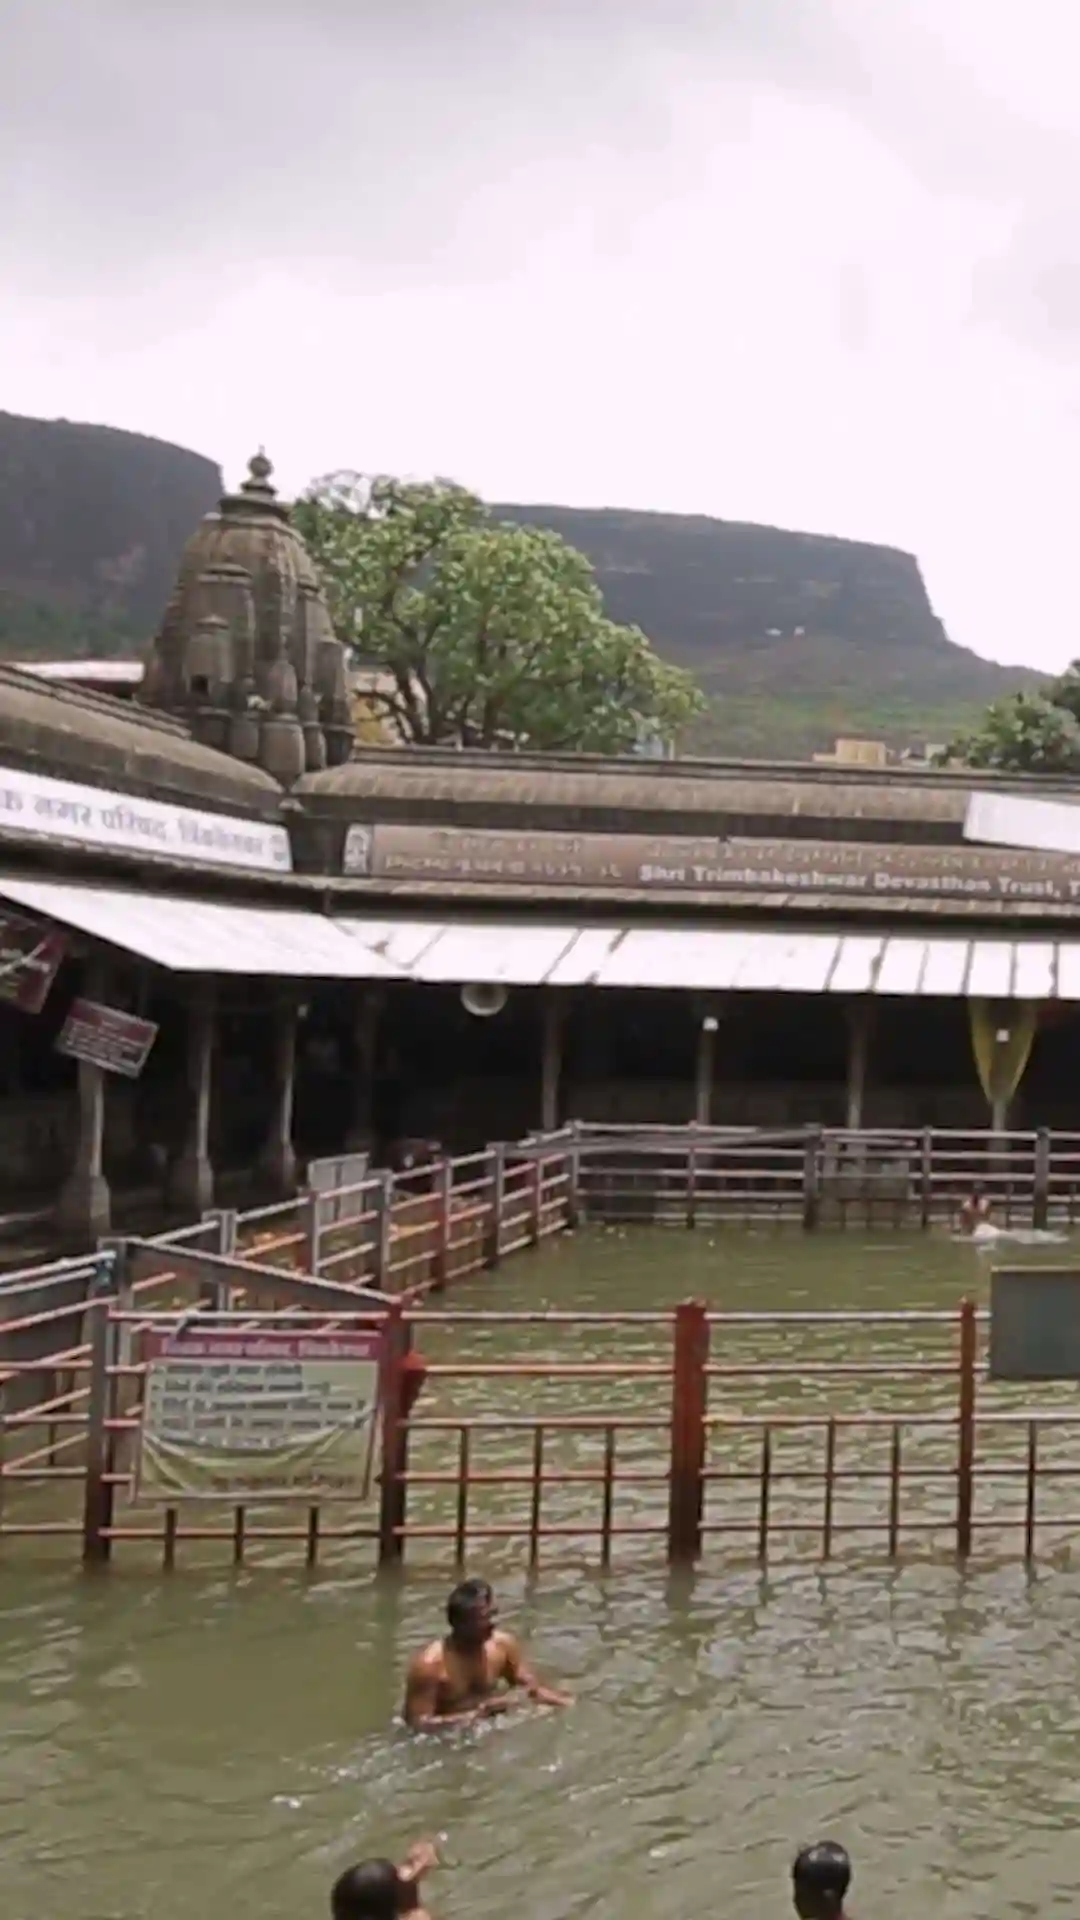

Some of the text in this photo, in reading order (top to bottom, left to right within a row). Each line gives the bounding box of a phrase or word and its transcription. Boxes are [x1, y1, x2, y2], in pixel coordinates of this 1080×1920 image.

[639, 863, 685, 883] Shri
[691, 864, 867, 888] Trimbakeshwar
[873, 871, 992, 892] Devasthan
